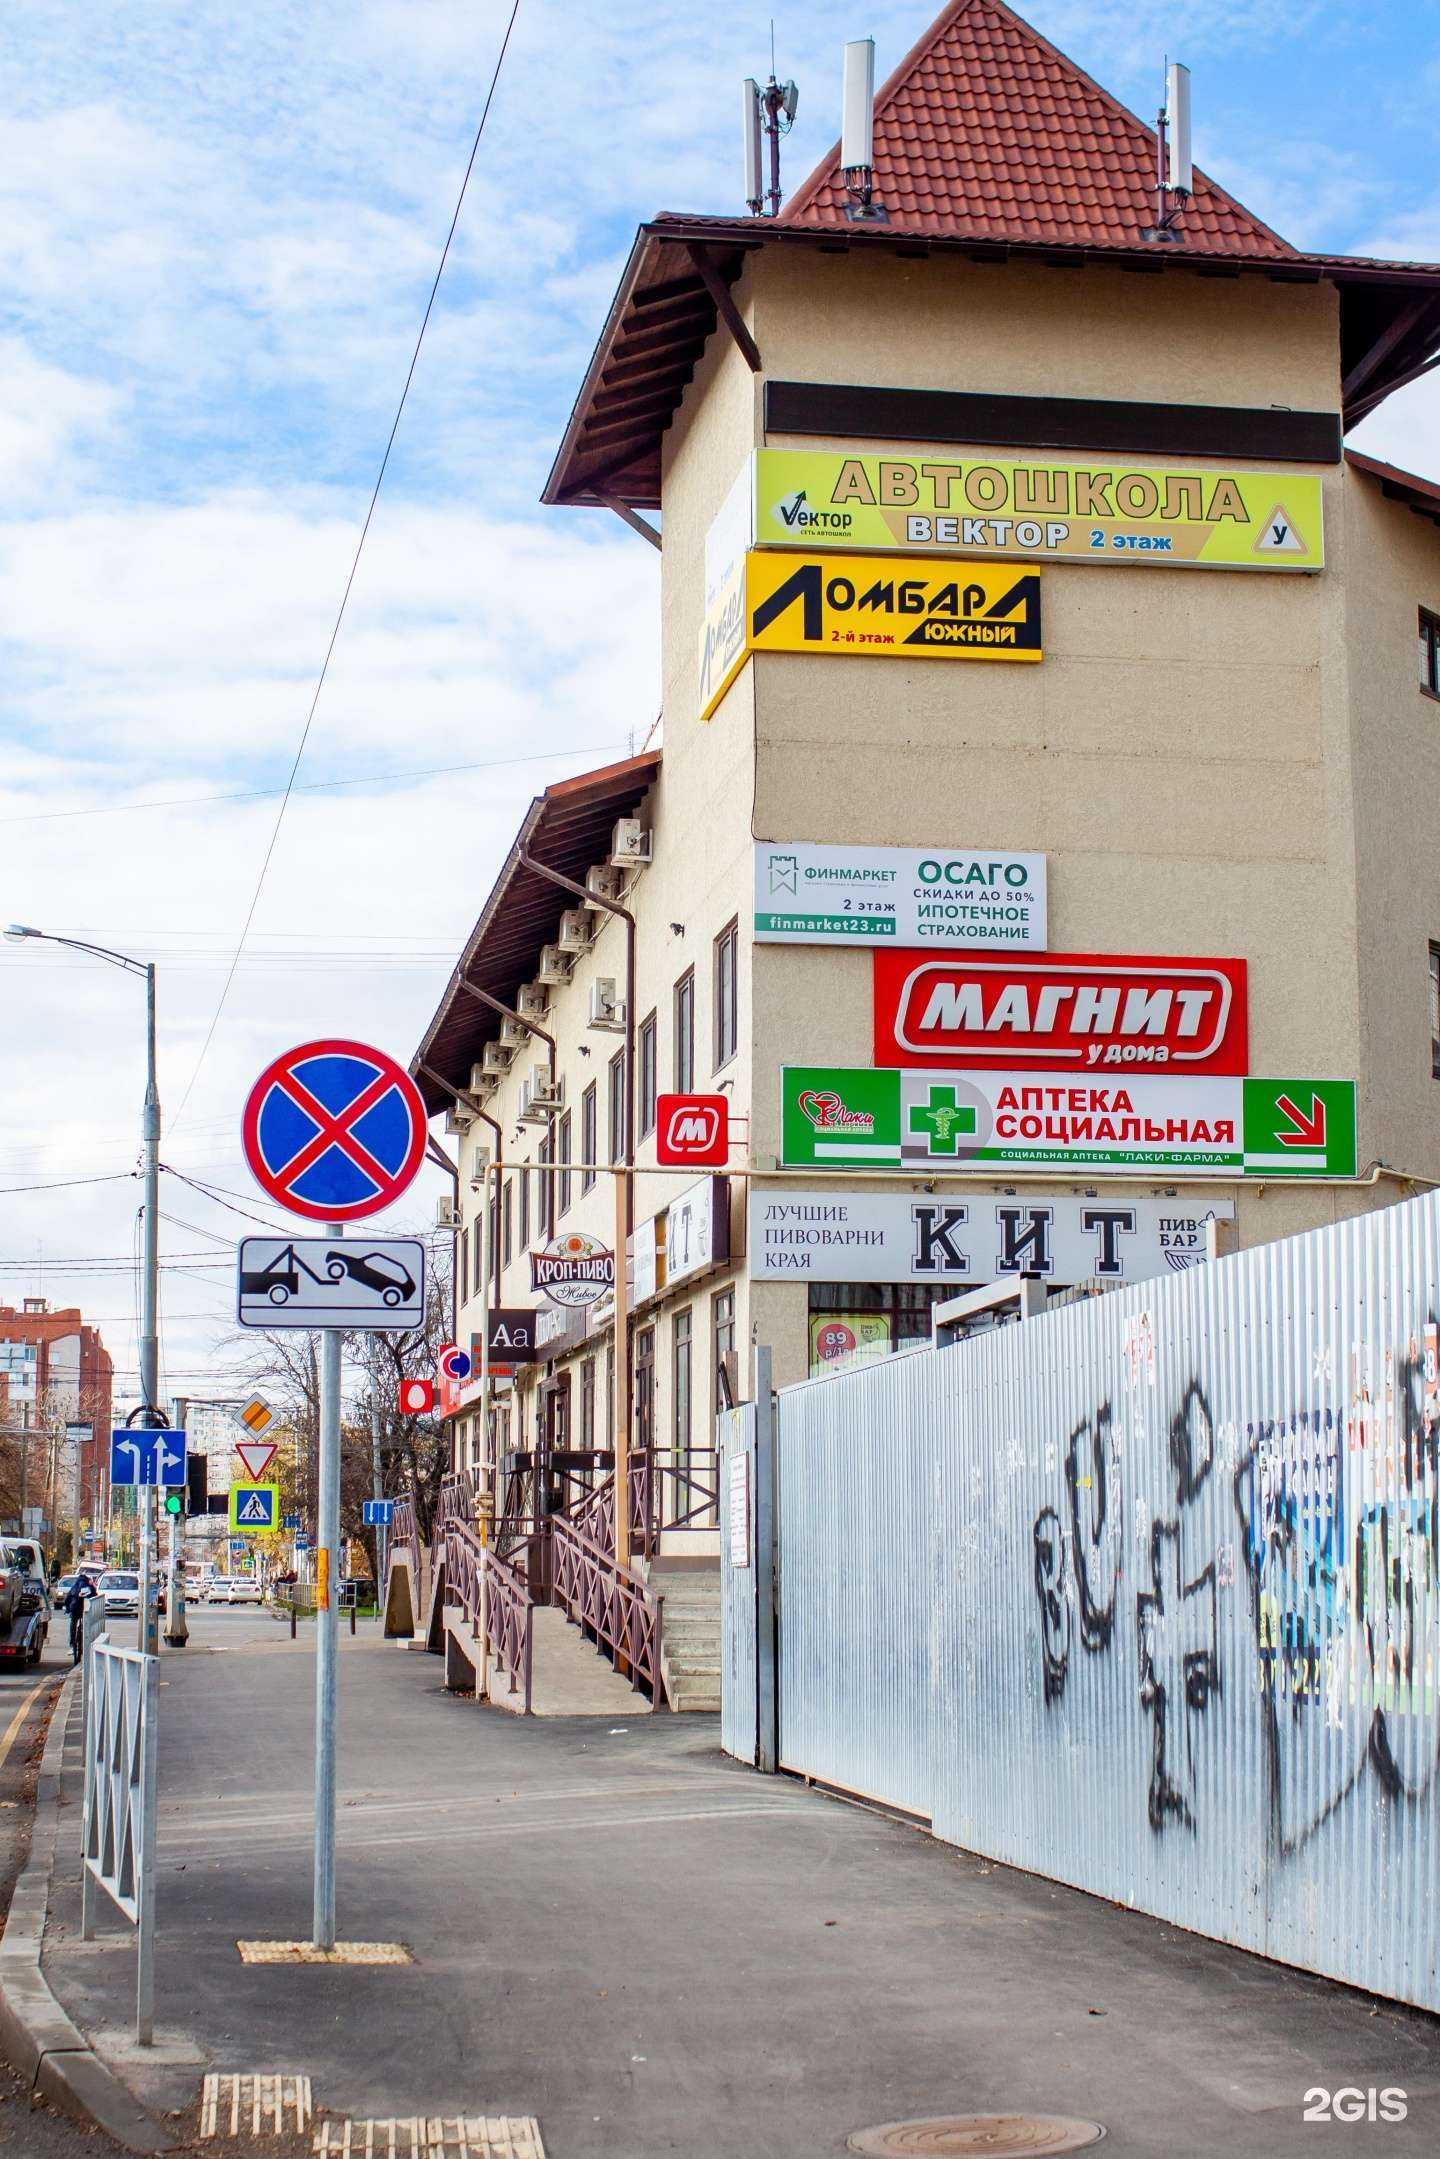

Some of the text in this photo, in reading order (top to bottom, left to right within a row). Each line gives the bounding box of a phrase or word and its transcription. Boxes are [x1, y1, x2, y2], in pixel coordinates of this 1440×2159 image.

[829, 459, 1251, 523] АВТОШКОЛА
[906, 515, 1173, 551] ВЕКТОР 2 этаж
[831, 630, 895, 644] 2-й этаж
[924, 623, 1016, 644] ЮЖНЫЙ
[804, 867, 897, 882] ФИНМАРКЕТ
[917, 860, 1029, 887] ОСАГО
[913, 888, 1035, 903] СКИДКИ ДО 50%
[843, 898, 896, 912] 2 этаж
[917, 904, 1030, 921] ИПОТЕЧНОЕ
[769, 916, 892, 932] finmarket23.ru
[917, 923, 1030, 939] СТРАХОВАНИЕ
[918, 982, 1214, 1037] МАГНИТ
[996, 1086, 1134, 1113] АПТЕКА
[675, 1117, 708, 1141] М
[995, 1114, 1235, 1144] СОЦИАЛЬНАЯ
[1000, 1151, 1230, 1163] СОЦИАЛЬНАЯ АПТЕКА "ЛАКИ-ФАРМА"
[764, 1205, 849, 1221] ЛУЧШИЕ
[765, 1229, 885, 1246] ПИВОВАРНИ
[911, 1204, 1137, 1276] КИТ
[1159, 1233, 1198, 1247] БАР
[765, 1252, 812, 1268] КРАЯ
[825, 1331, 847, 1345] 89
